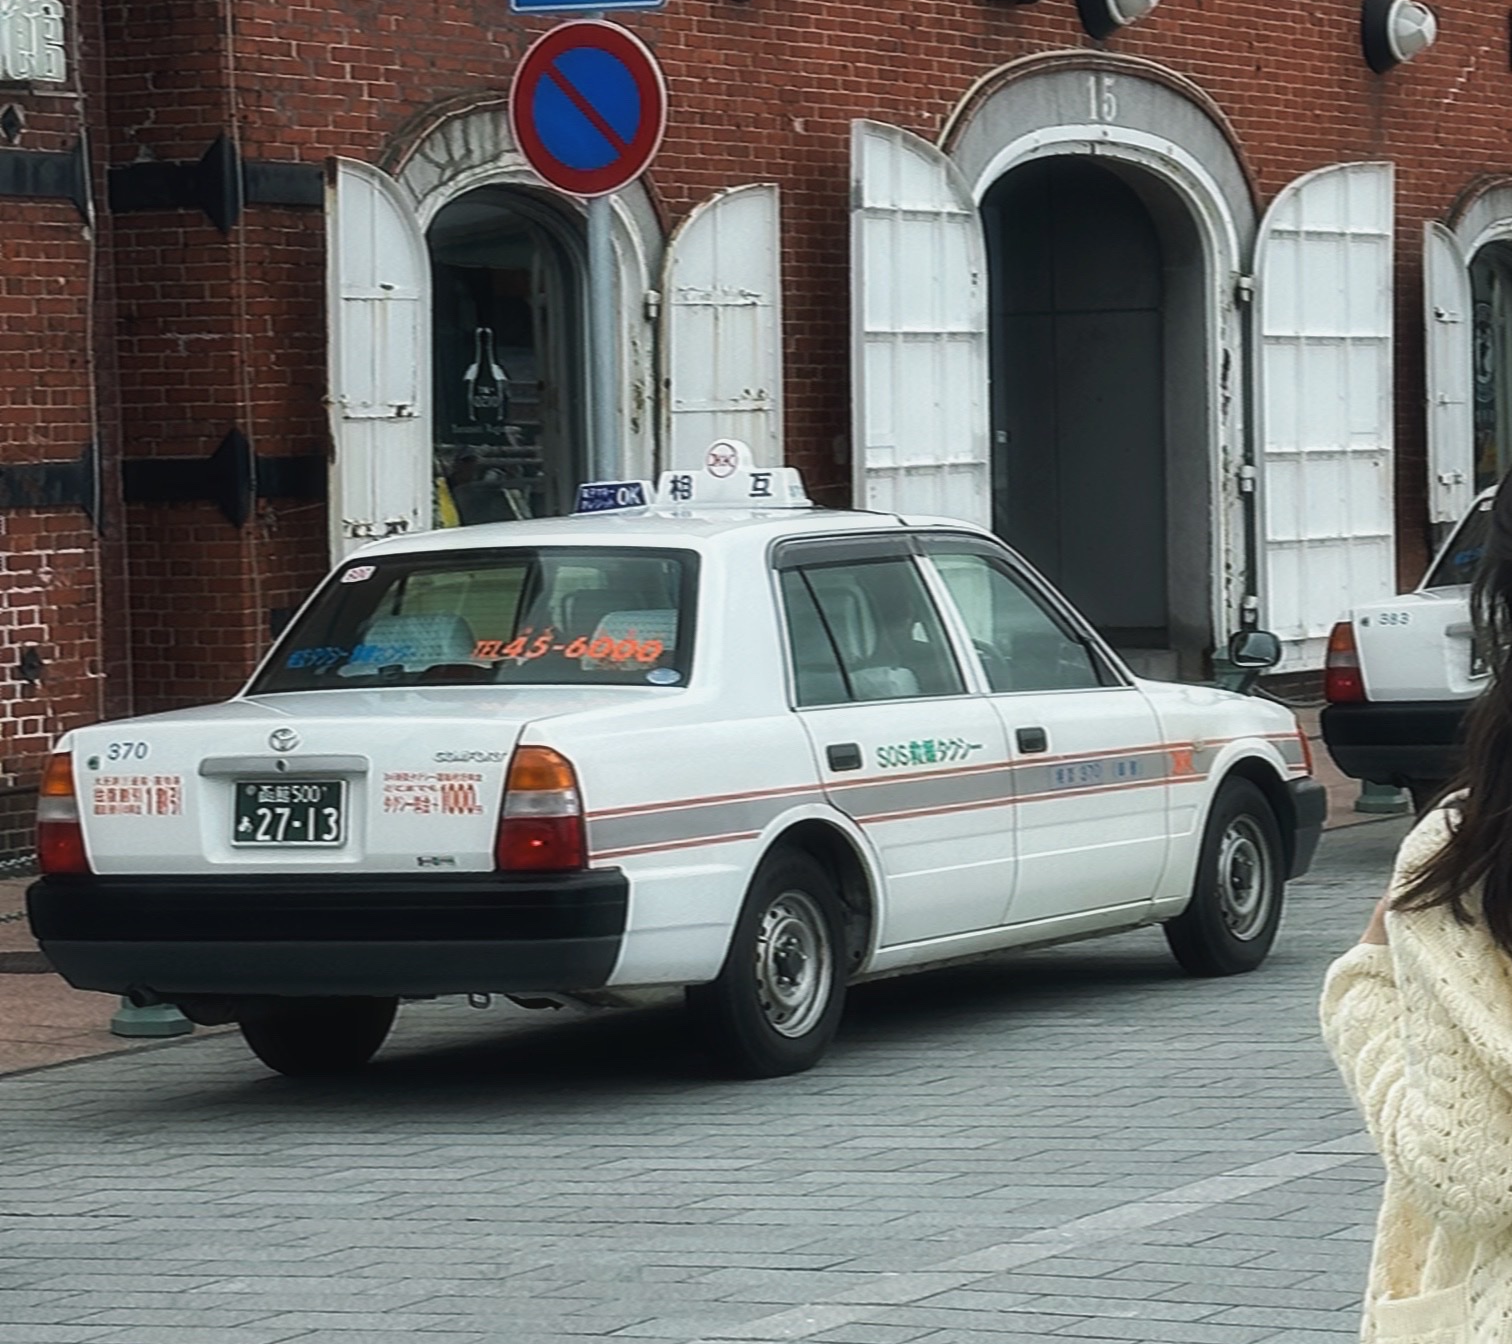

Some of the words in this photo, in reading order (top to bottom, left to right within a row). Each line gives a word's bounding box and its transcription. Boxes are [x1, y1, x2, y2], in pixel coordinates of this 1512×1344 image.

[1087, 76, 1117, 122] 15
[749, 472, 772, 497] 互
[617, 487, 641, 506] OK
[107, 742, 149, 761] 370
